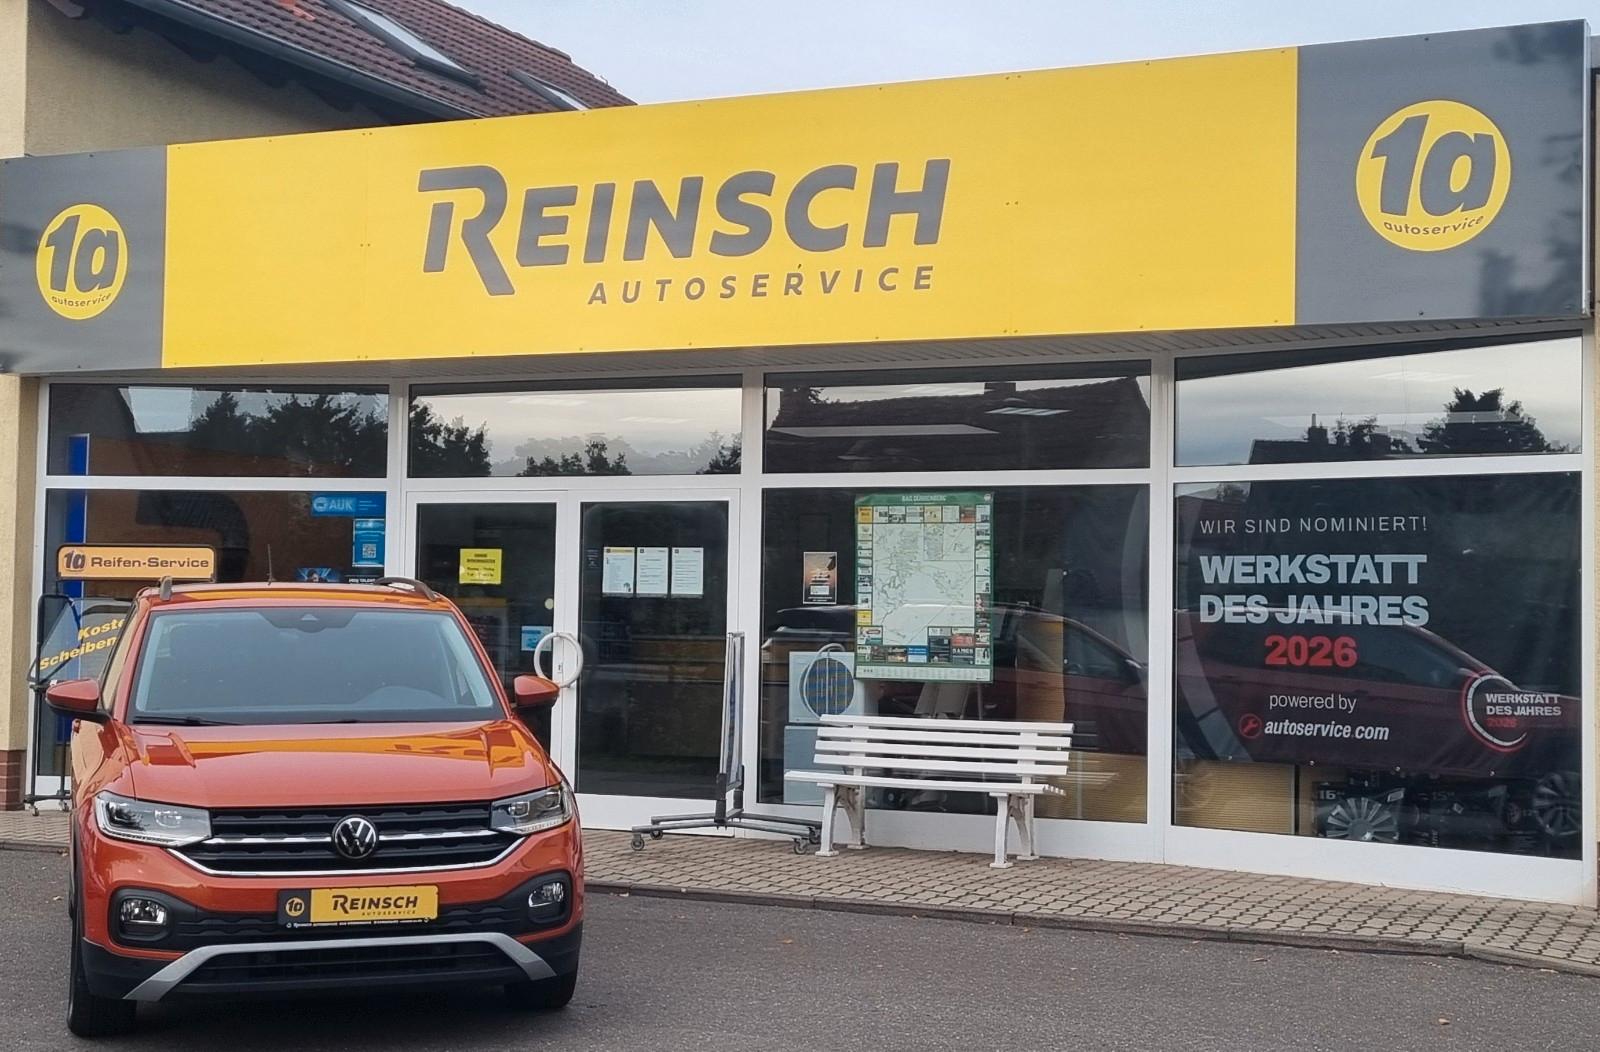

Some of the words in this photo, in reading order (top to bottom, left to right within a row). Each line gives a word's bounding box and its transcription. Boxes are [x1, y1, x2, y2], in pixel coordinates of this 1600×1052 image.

[1370, 113, 1497, 217] 1a
[417, 157, 951, 297] REINSCH
[1383, 214, 1485, 235] autoservice
[45, 214, 119, 293] 1a
[587, 265, 934, 305] AUTOSERVICE
[51, 292, 112, 307] autoservice
[1200, 519, 1236, 534] WIR
[1245, 518, 1291, 534] SIND
[1300, 516, 1428, 533] NOMINIERT!
[64, 550, 86, 569] 1a
[90, 556, 209, 568] Reifen-Service
[1199, 554, 1428, 585] WERKSTATT
[1199, 594, 1269, 624] DES
[1274, 594, 1430, 627] JAHRES
[1264, 635, 1358, 668] 2026
[1269, 693, 1334, 710] powered
[1338, 694, 1358, 714] by
[1485, 693, 1559, 704] WERKSTATT
[1486, 705, 1512, 716] DES
[1514, 706, 1562, 717] JAHRES
[1264, 719, 1390, 741] autoservice.com
[332, 894, 418, 914] REINSCH
